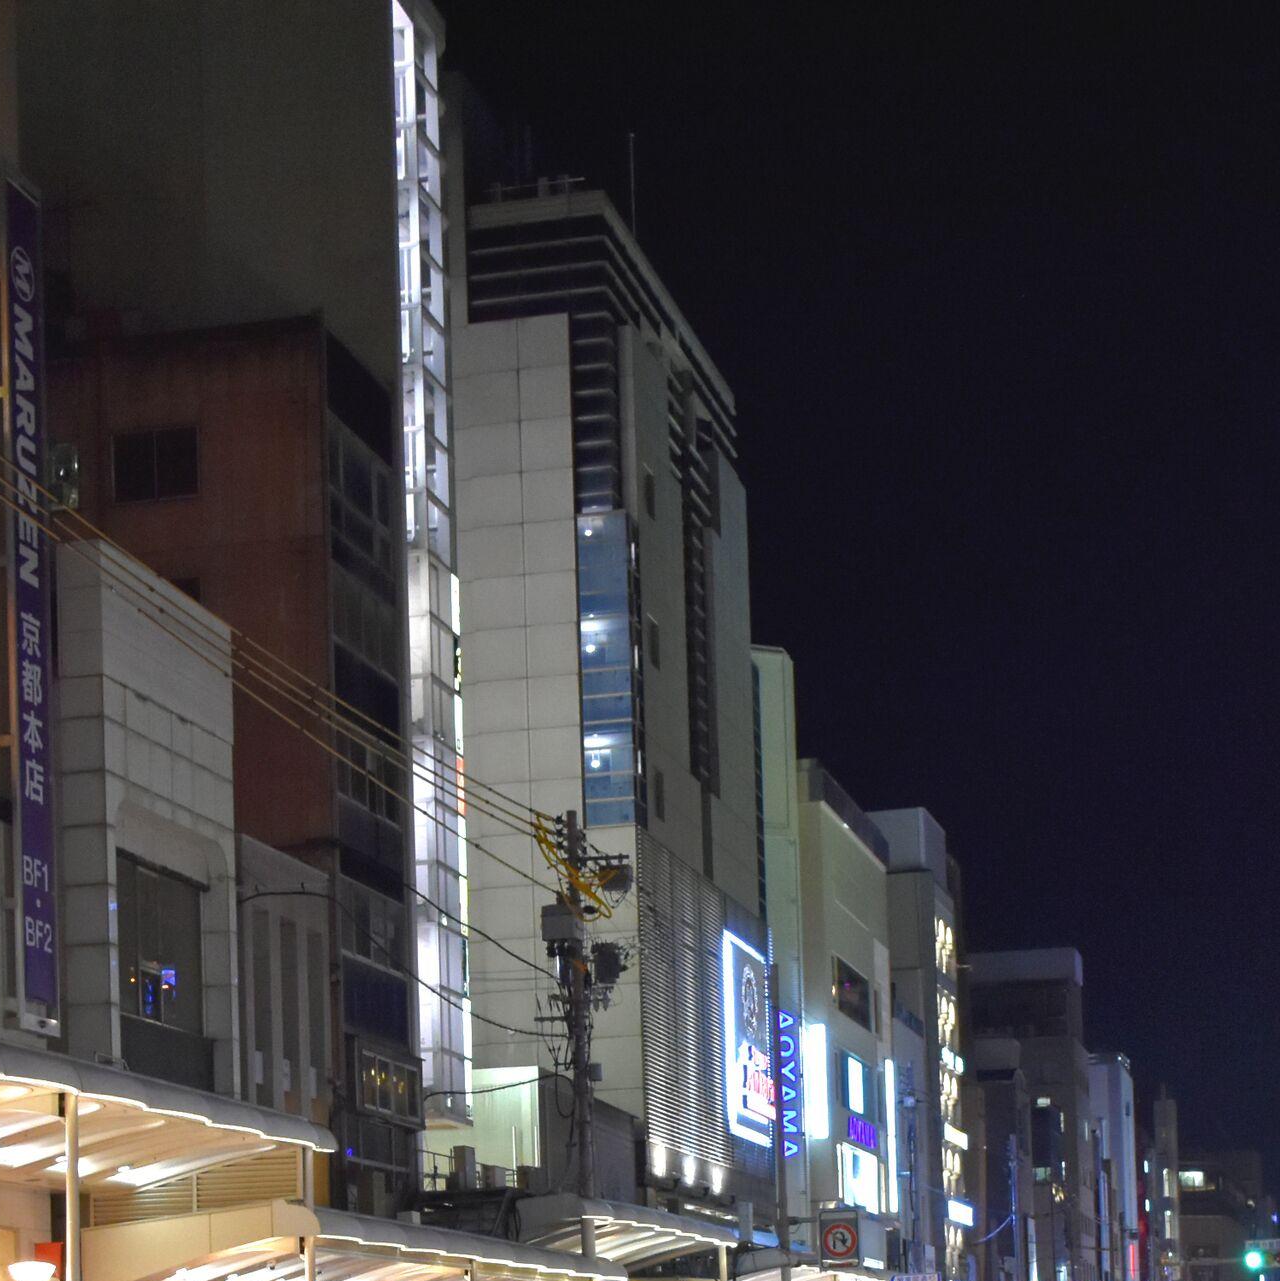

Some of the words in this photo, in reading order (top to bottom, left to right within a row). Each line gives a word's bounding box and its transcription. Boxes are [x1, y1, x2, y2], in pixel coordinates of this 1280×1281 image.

[13, 310, 40, 588] MARUZEN
[20, 611, 45, 806] 京都本店
[22, 854, 49, 893] BF1
[25, 916, 54, 954] BF2
[778, 1011, 798, 1158] AOYAMA
